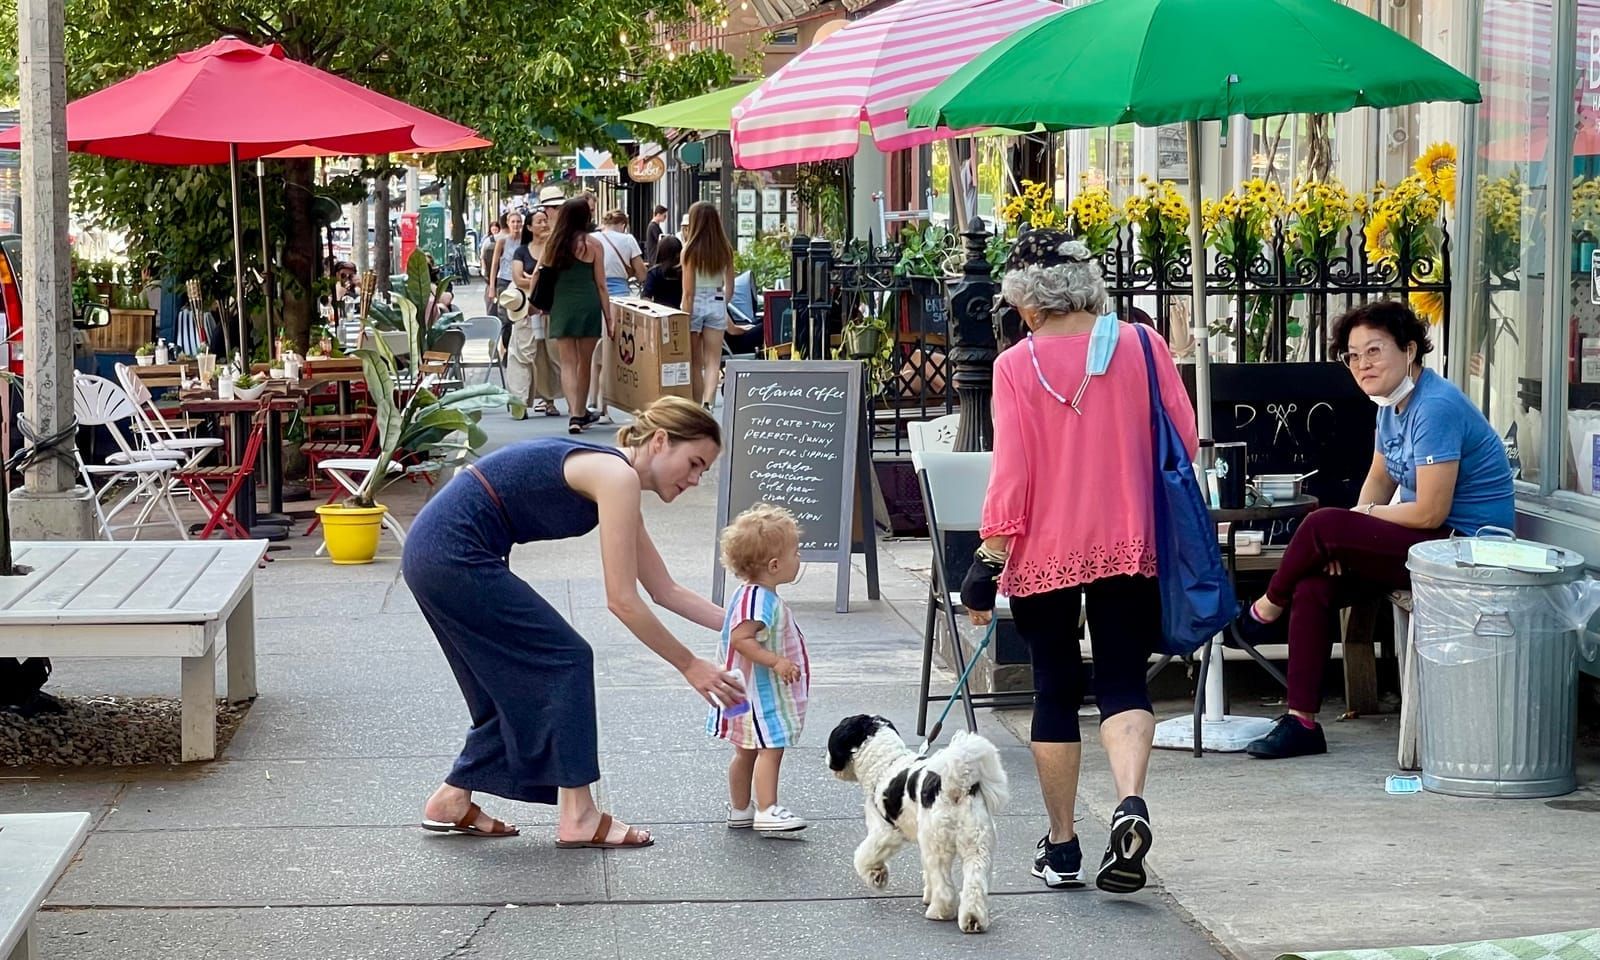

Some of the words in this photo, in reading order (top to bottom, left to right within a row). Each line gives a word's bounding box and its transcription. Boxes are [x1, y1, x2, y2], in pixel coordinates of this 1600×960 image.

[751, 416, 772, 427] THE
[747, 445, 775, 455] SPOT
[778, 448, 797, 457] FOR
